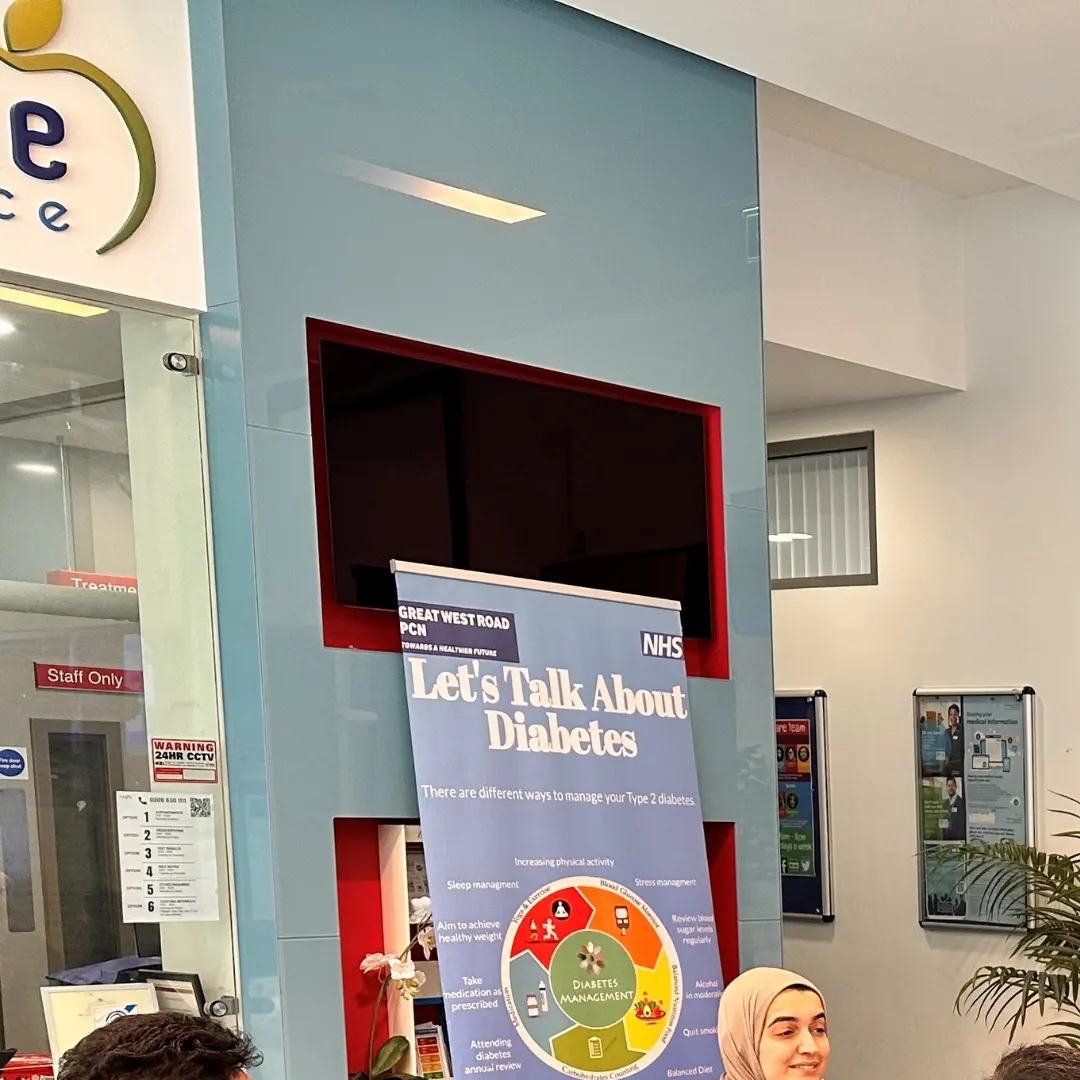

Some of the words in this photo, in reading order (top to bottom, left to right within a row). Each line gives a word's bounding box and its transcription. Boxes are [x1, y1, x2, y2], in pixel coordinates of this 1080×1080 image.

[398, 605, 440, 622] GREAT
[440, 610, 476, 626] WEST
[476, 614, 510, 630] ROAD
[400, 621, 427, 636] PCN
[401, 641, 432, 651] TOWARDS
[433, 644, 439, 652] A
[439, 645, 473, 655] HEALTHIER
[473, 648, 498, 657] FUTURE
[643, 632, 683, 659] NHS
[47, 668, 83, 684] Staff
[88, 671, 123, 688] Only
[408, 657, 500, 704] Let's
[502, 665, 587, 711] Talk
[591, 673, 688, 720] About
[483, 709, 638, 758] Diabetes
[154, 741, 214, 752] WARNING
[155, 751, 183, 760] 24HR
[187, 752, 214, 761] CCTV
[421, 784, 456, 798] There
[458, 788, 477, 798] are
[478, 786, 524, 800] different
[524, 790, 551, 802] ways
[553, 789, 564, 801] to
[565, 792, 603, 805] manage
[604, 793, 625, 805] your
[626, 791, 649, 806] Type
[650, 792, 657, 804] 2
[144, 811, 149, 822] 1
[144, 829, 151, 841] 2
[145, 848, 152, 859] 3
[514, 858, 555, 868] Increasing
[556, 858, 585, 868] physical
[586, 858, 615, 868] activity
[146, 866, 153, 877] 4
[447, 880, 471, 891] Sleep
[634, 877, 656, 887] Stress
[147, 884, 154, 895] 5
[148, 901, 155, 912] 6
[600, 880, 619, 892] Blood
[619, 887, 641, 906] Glucose
[641, 904, 660, 929] Monitor
[671, 914, 697, 923] Review
[697, 913, 714, 923] blood
[437, 920, 456, 931] Aim
[458, 921, 467, 930] to
[468, 919, 500, 929] achieve
[676, 926, 695, 935] sugar
[438, 932, 472, 943] healthy
[474, 931, 502, 942] weight
[682, 936, 711, 945] regularly
[462, 976, 483, 986] Take
[572, 978, 618, 990] DIABETES
[695, 980, 718, 989] Alcohol
[442, 988, 492, 999] medication
[493, 988, 502, 996] as
[560, 991, 634, 1004] MANAGEMENT
[685, 991, 693, 999] in
[451, 1000, 499, 1012] prescribed
[682, 1027, 699, 1037] Quit
[470, 1038, 512, 1049] Attending
[475, 1051, 511, 1061] diabetes
[464, 1064, 495, 1074] annual
[495, 1062, 522, 1071] review
[609, 1063, 640, 1079] Counting
[666, 1067, 697, 1078] Balanced
[698, 1065, 714, 1074] Diet
